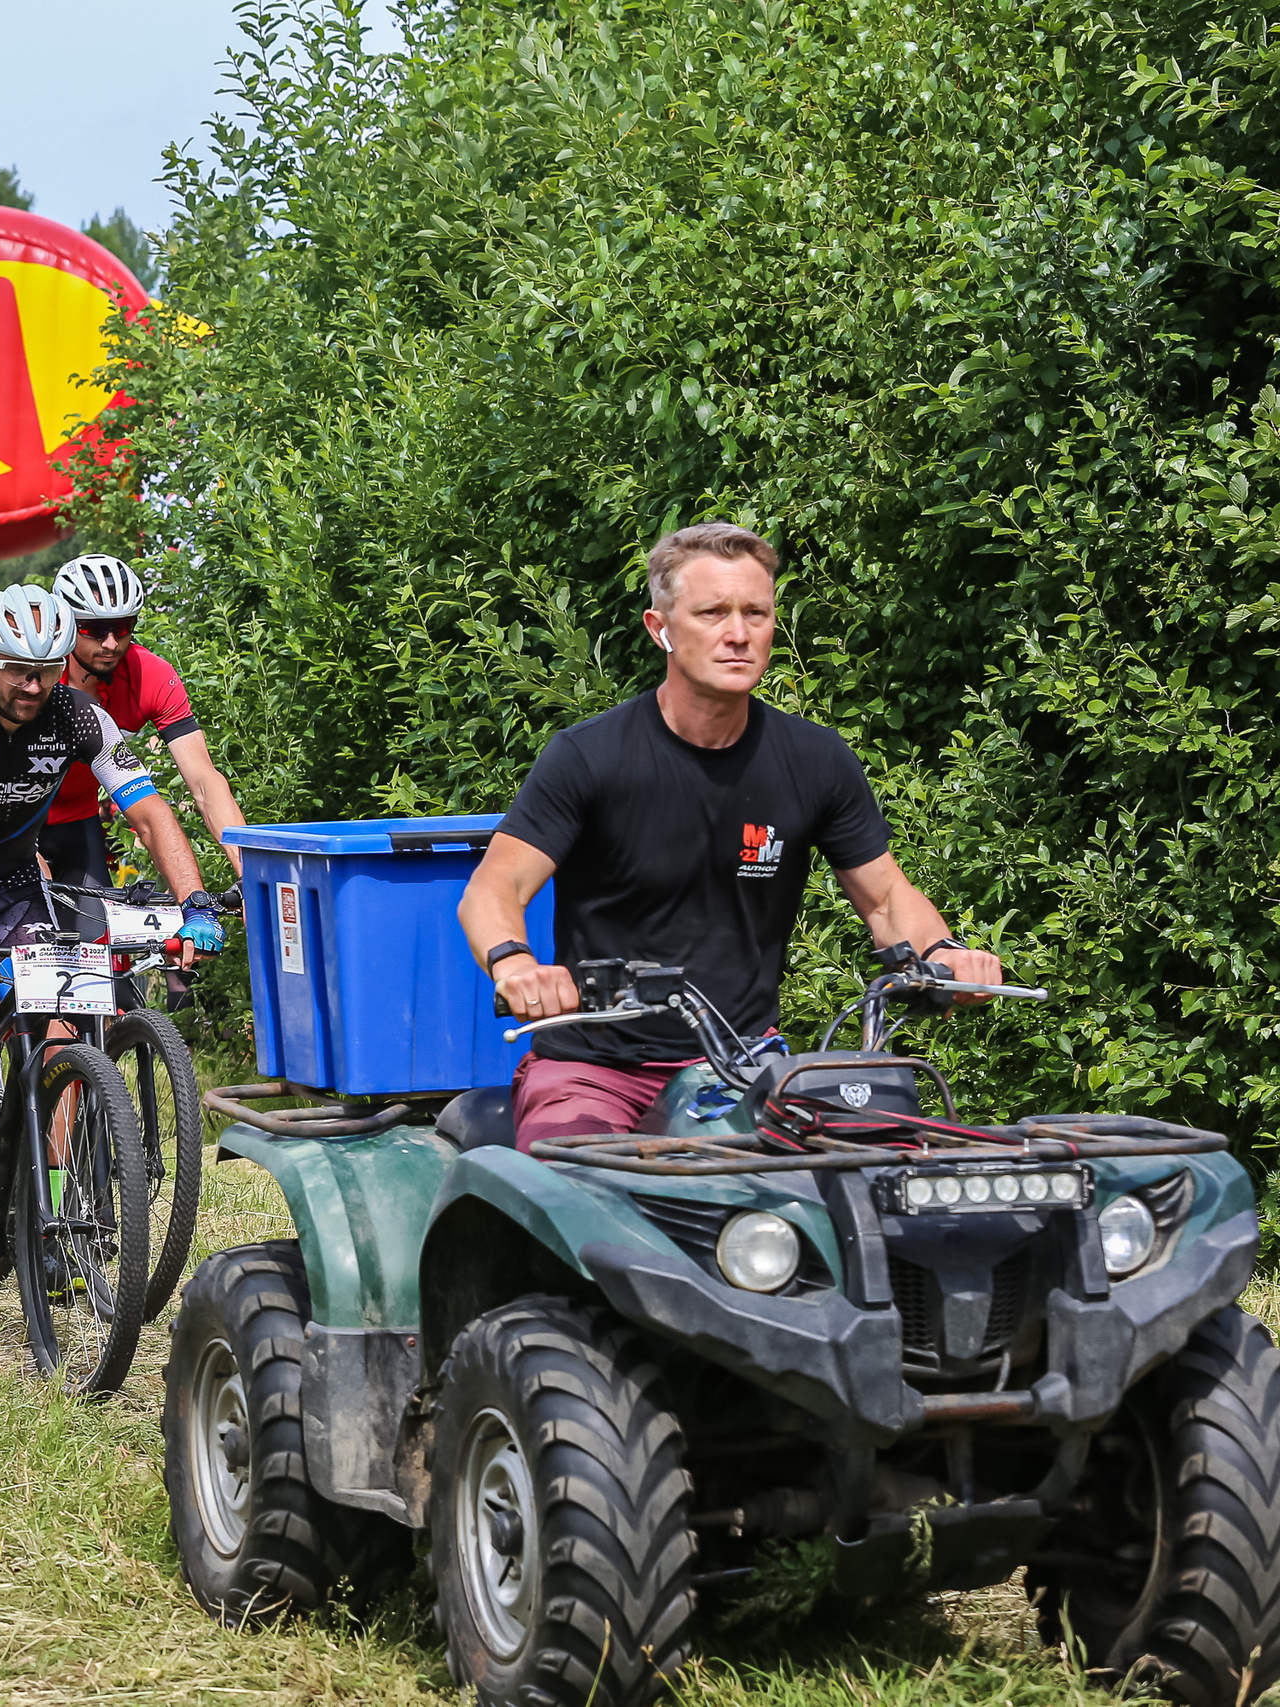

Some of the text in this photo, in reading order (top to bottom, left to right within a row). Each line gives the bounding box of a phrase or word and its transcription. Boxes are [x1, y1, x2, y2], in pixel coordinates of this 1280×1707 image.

[27, 756, 68, 774] XY
[143, 913, 162, 931] 4
[81, 947, 89, 959] 3
[55, 971, 75, 998] 2
[43, 1062, 73, 1088] MAXXIS
